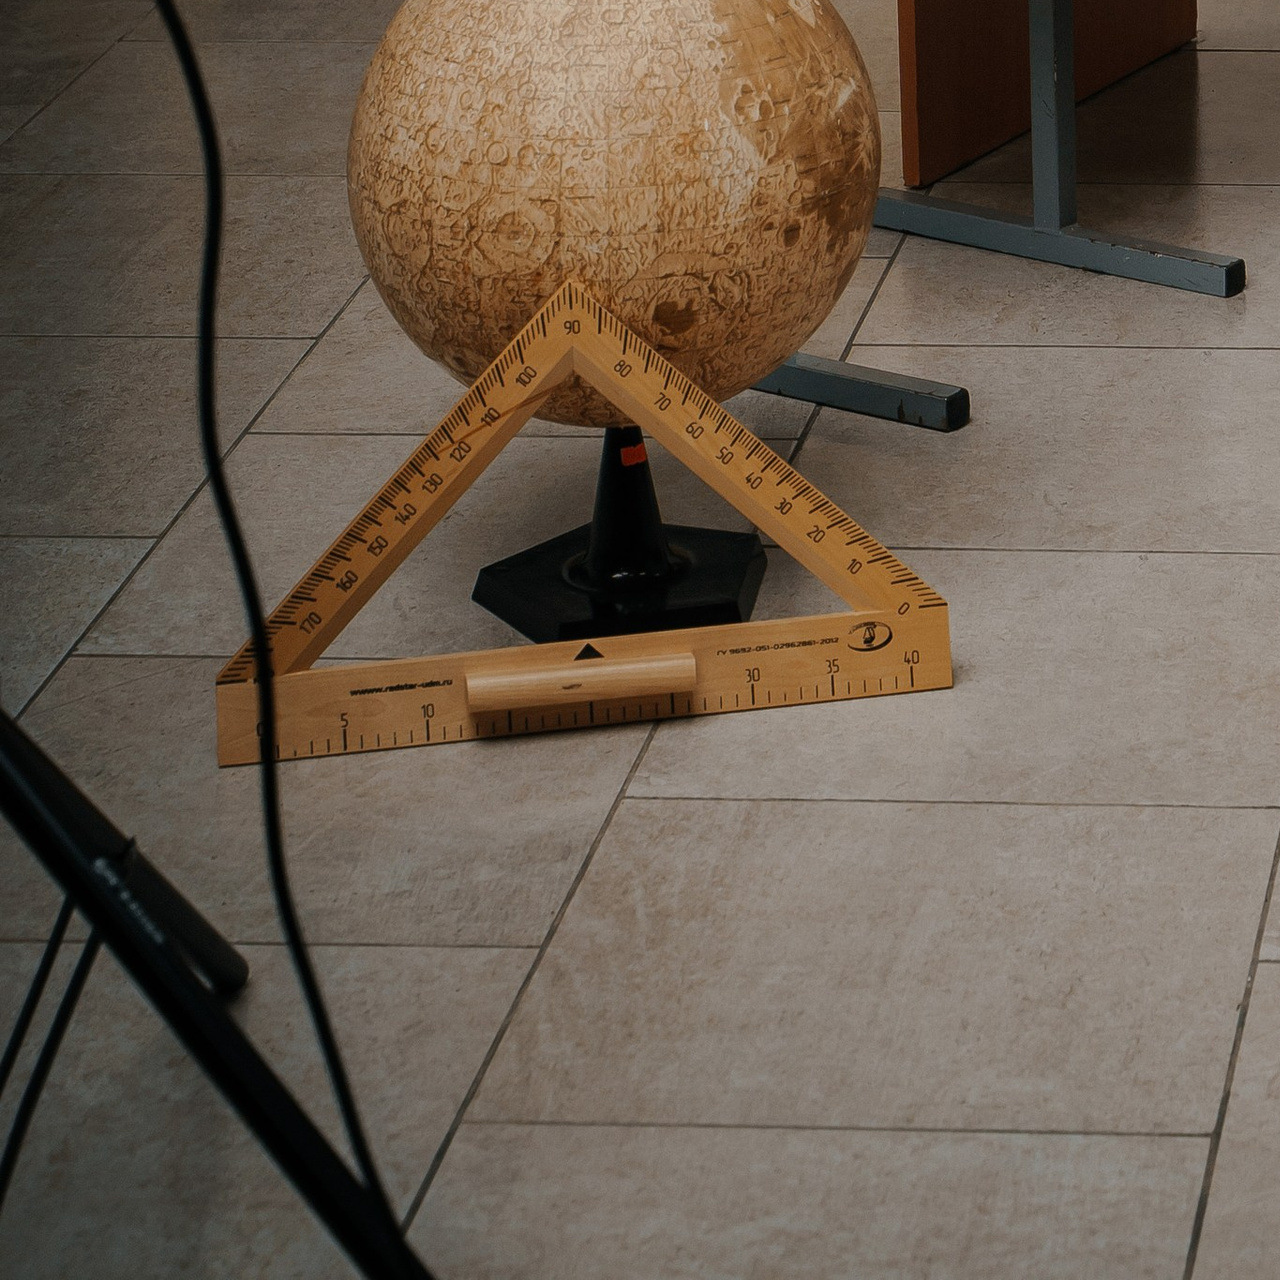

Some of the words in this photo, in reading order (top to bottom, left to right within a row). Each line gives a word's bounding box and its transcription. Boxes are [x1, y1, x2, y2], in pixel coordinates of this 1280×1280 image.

[299, 611, 322, 634] 170
[335, 570, 359, 593] 160
[366, 535, 389, 558] 150
[394, 503, 417, 526] 140
[421, 472, 444, 494] 130
[449, 440, 472, 464] 120
[480, 406, 501, 427] 110
[515, 365, 537, 387] 100
[563, 320, 581, 335] 90
[613, 359, 632, 377] 80
[654, 392, 672, 412] 70
[685, 421, 704, 439] 60
[715, 446, 734, 465] 50
[745, 471, 763, 490] 40
[774, 497, 793, 516] 30
[806, 525, 825, 543] 20
[847, 558, 863, 575] 10
[897, 602, 910, 616] 0
[340, 713, 349, 728] 5
[421, 703, 435, 719] 10
[745, 667, 761, 683] 30
[825, 658, 840, 674] 35
[903, 650, 920, 665] 40
